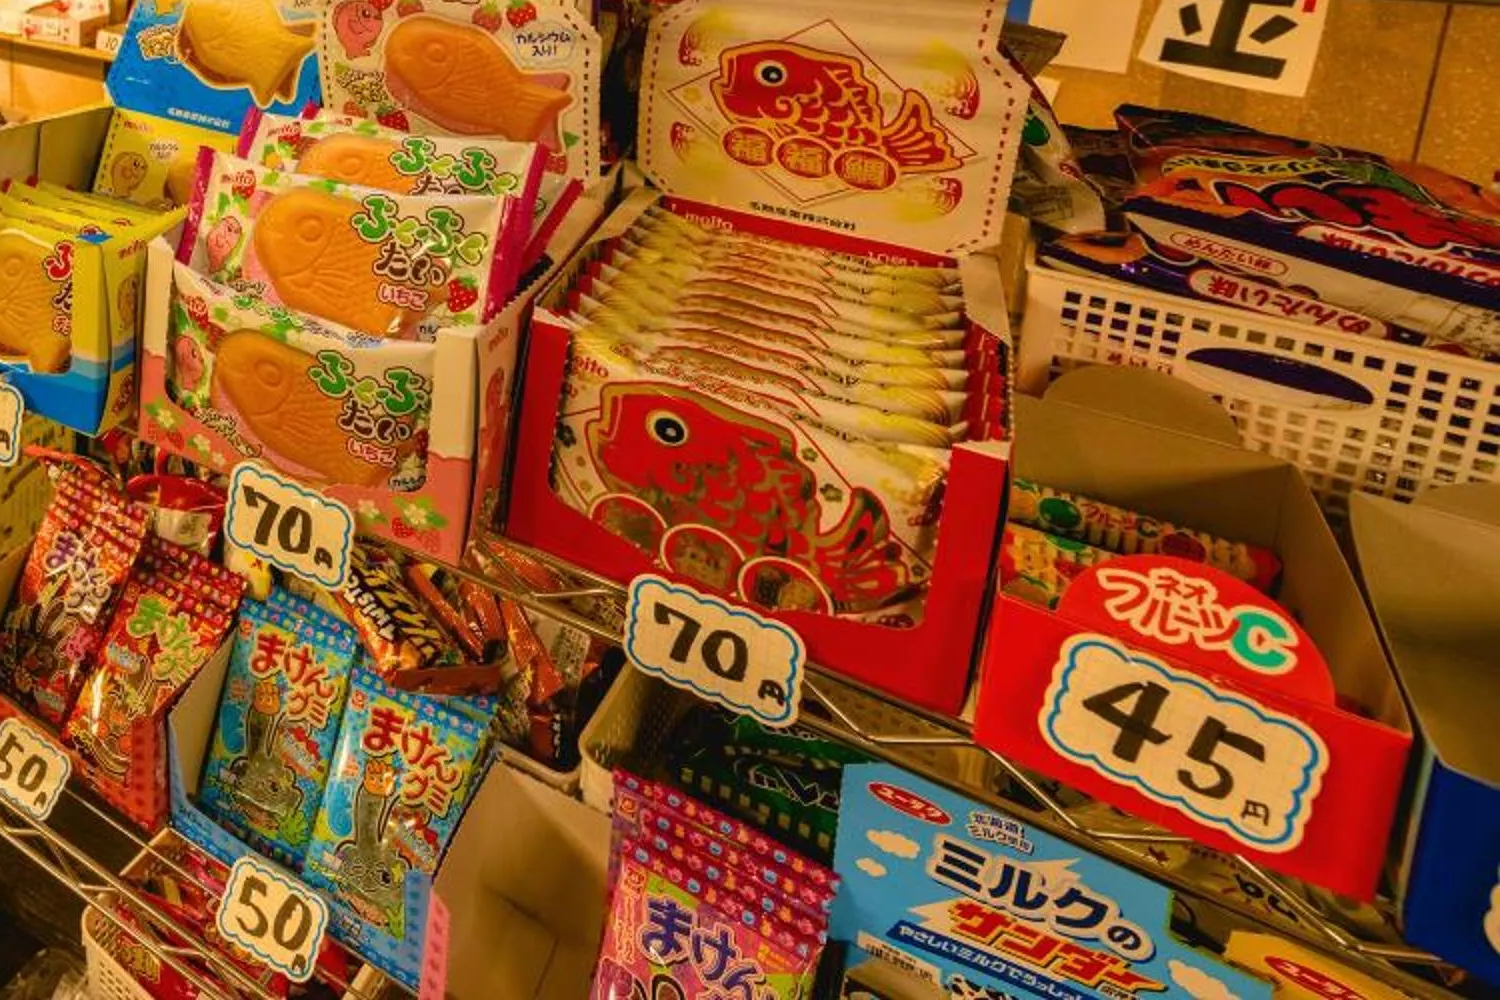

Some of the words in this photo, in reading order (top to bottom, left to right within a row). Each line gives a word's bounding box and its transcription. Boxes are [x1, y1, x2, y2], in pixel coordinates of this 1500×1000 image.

[516, 32, 572, 45] カルシウム
[372, 241, 448, 287] たい
[1184, 234, 1274, 270] めんたい味
[378, 283, 429, 311] いちご
[1209, 274, 1372, 335] めんたい味
[570, 350, 609, 380] eito
[337, 401, 413, 444] たい
[346, 439, 398, 466] いちご
[243, 485, 333, 570] 70円
[1155, 574, 1209, 602] ネオ
[1100, 572, 1298, 672] フルーツC
[253, 630, 334, 700] まけん
[654, 602, 786, 706] 70円
[289, 690, 330, 730] グミ
[364, 705, 459, 788] まけん
[1082, 680, 1269, 827] 45円
[404, 772, 450, 815] グミ
[876, 787, 943, 818] ユーラク
[934, 839, 1143, 952] ミルクの
[238, 875, 312, 972] 50円
